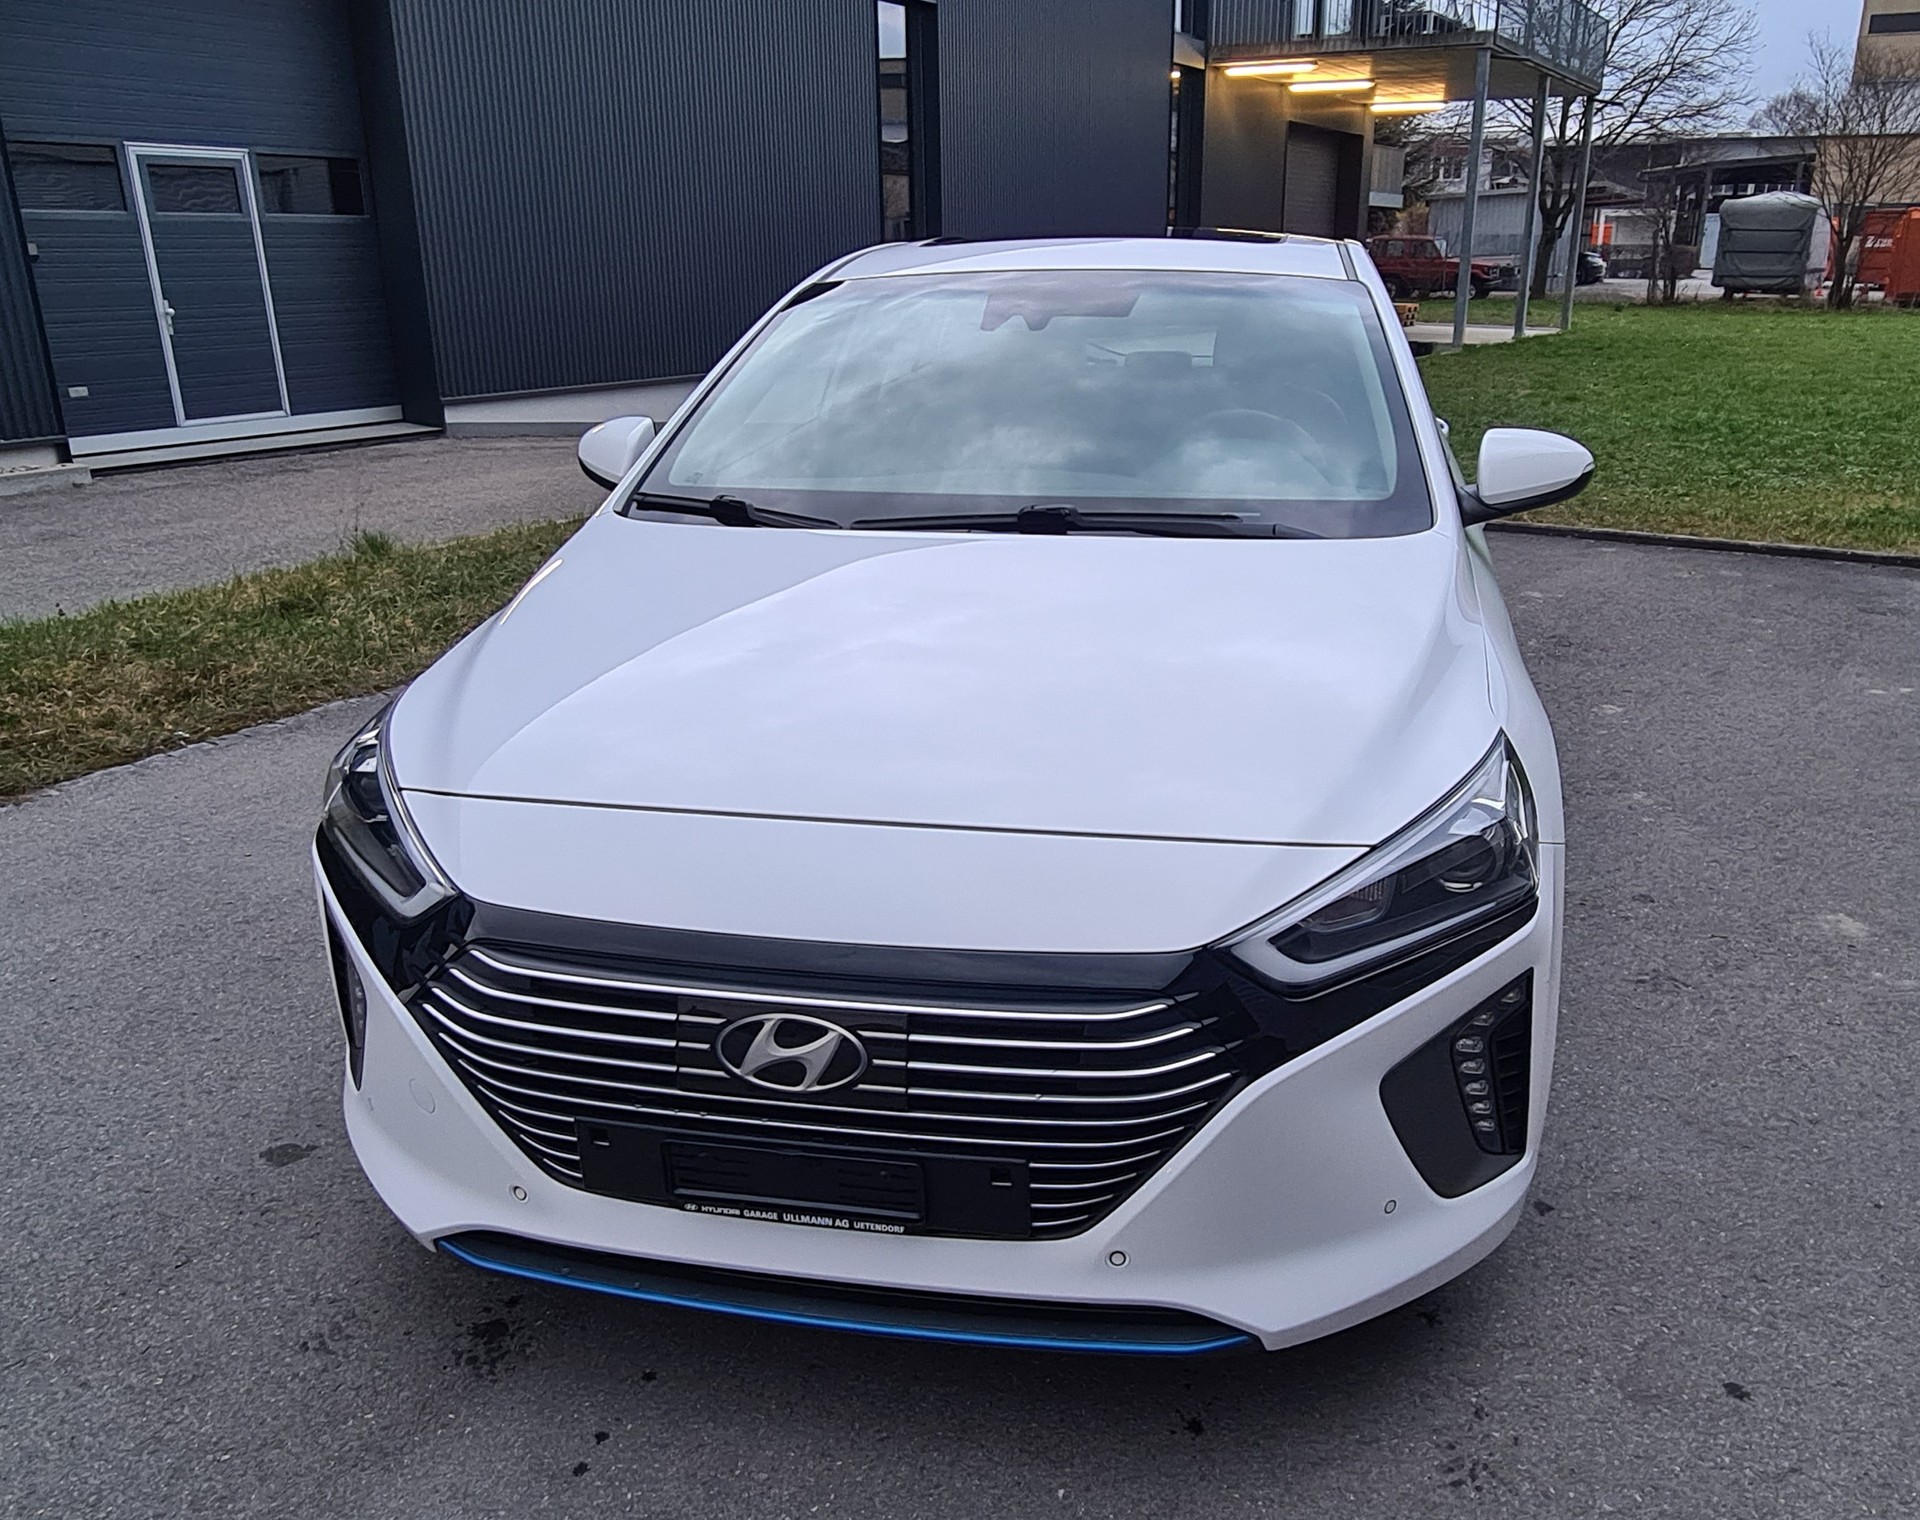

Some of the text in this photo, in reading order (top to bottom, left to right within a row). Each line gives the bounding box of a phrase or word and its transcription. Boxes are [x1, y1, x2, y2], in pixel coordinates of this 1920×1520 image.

[701, 1206, 905, 1233] HYUNDAI GARAGE ULLMANN AG UETENDORF
